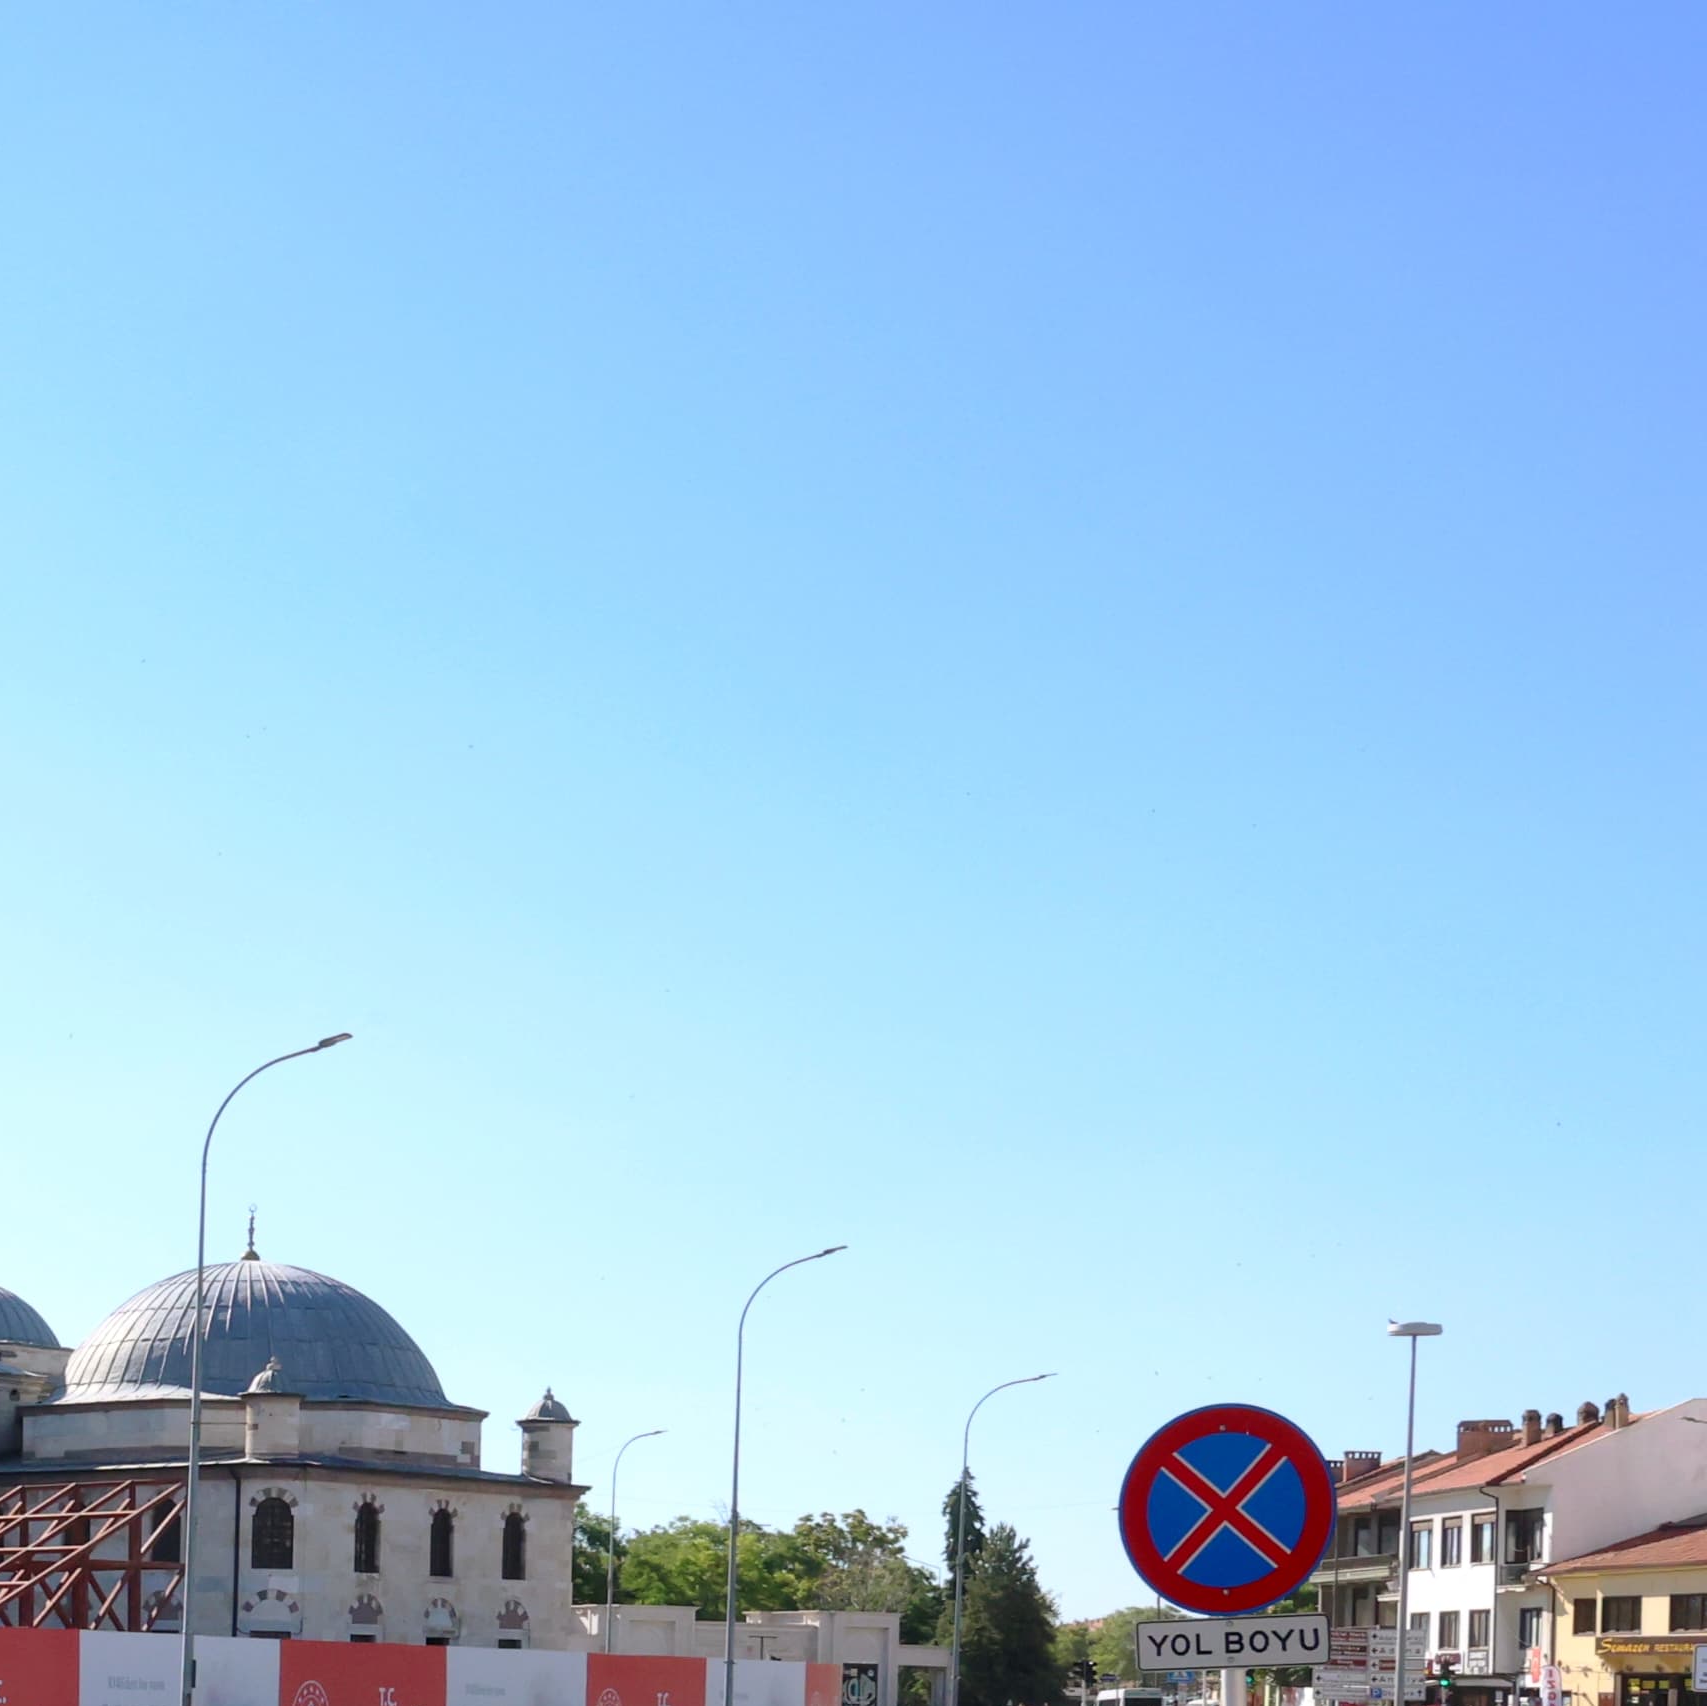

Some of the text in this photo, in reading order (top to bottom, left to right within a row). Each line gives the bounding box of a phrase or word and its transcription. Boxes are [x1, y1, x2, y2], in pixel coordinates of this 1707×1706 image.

[1147, 1633, 1212, 1656] YOL
[1225, 1628, 1319, 1654] BOYU
[378, 1686, 397, 1706] T.C.
